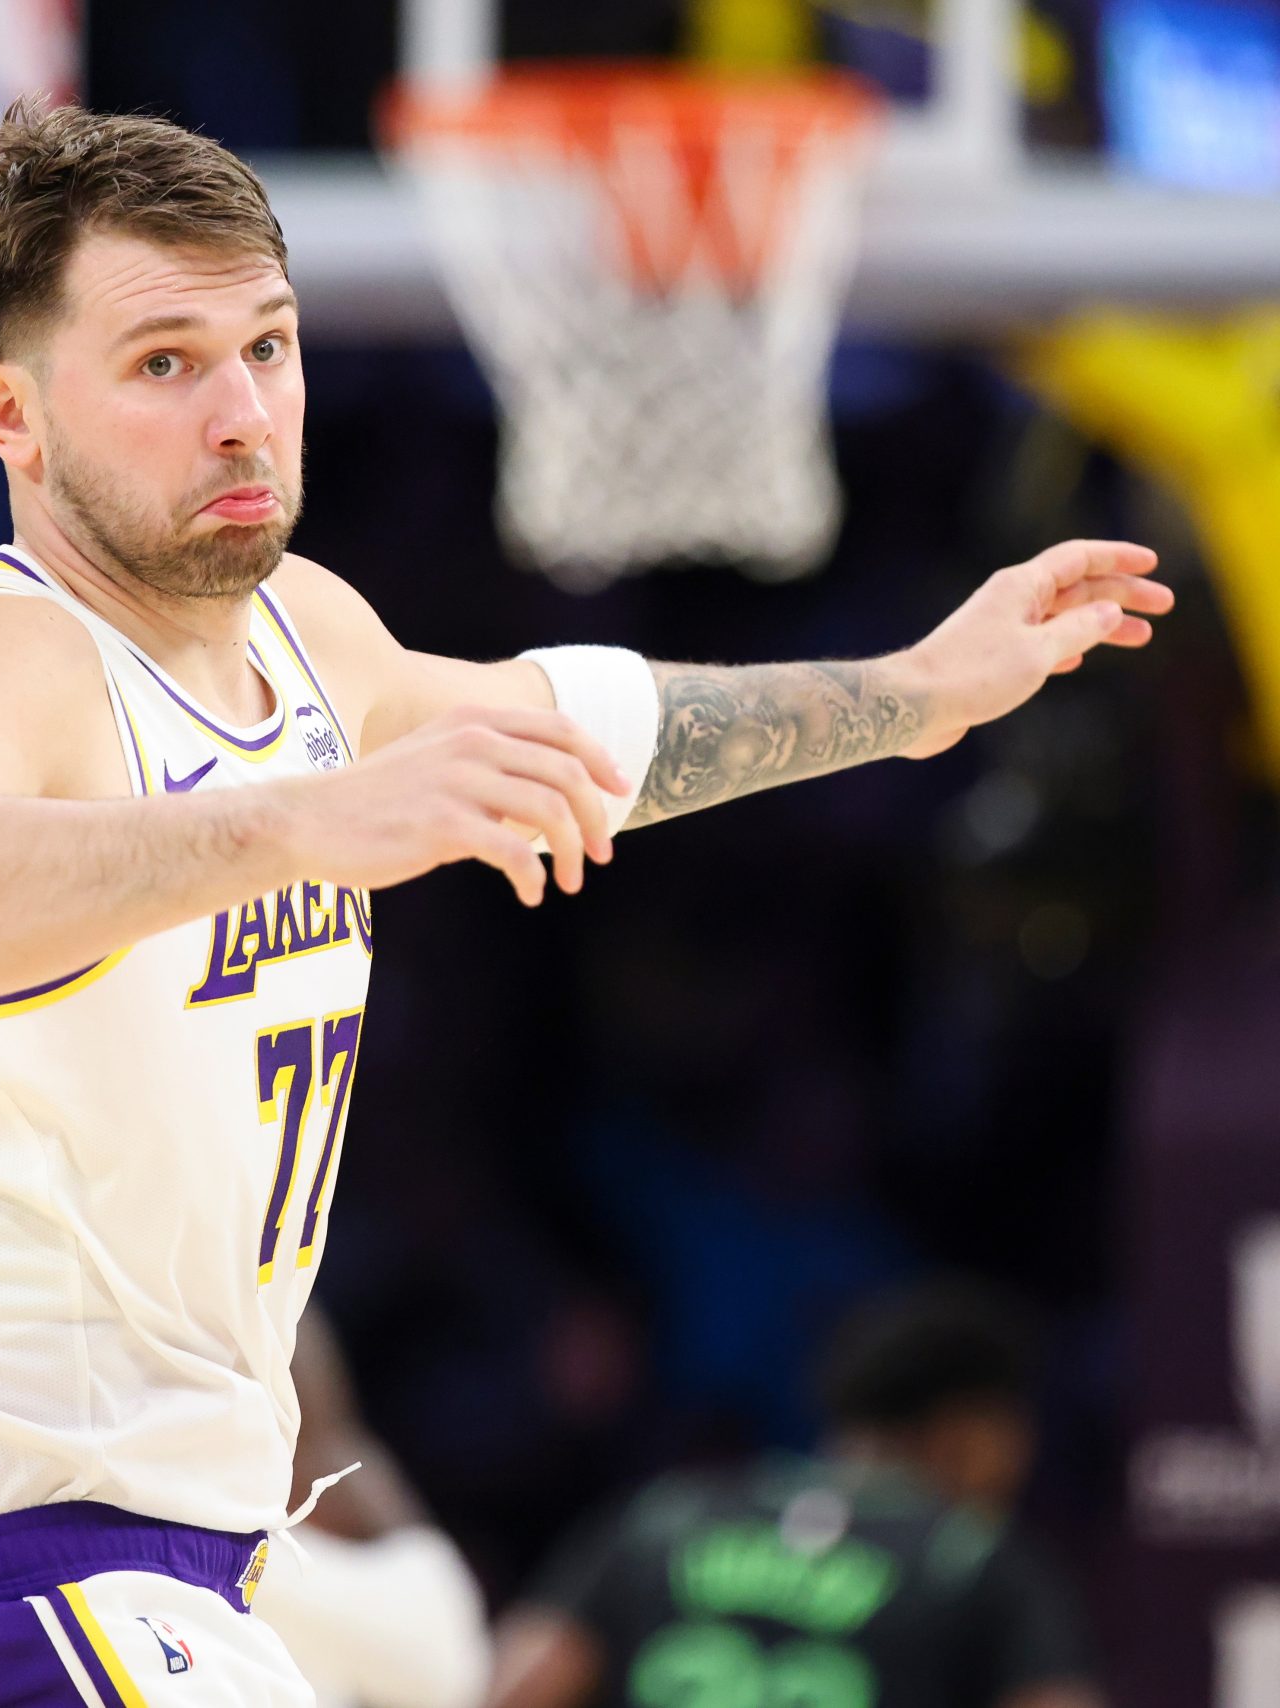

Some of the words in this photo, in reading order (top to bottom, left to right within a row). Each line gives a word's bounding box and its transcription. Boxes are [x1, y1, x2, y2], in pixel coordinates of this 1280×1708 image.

[305, 727, 339, 761] bibigo
[254, 1003, 366, 1288] 77
[169, 1655, 186, 1672] NBA
